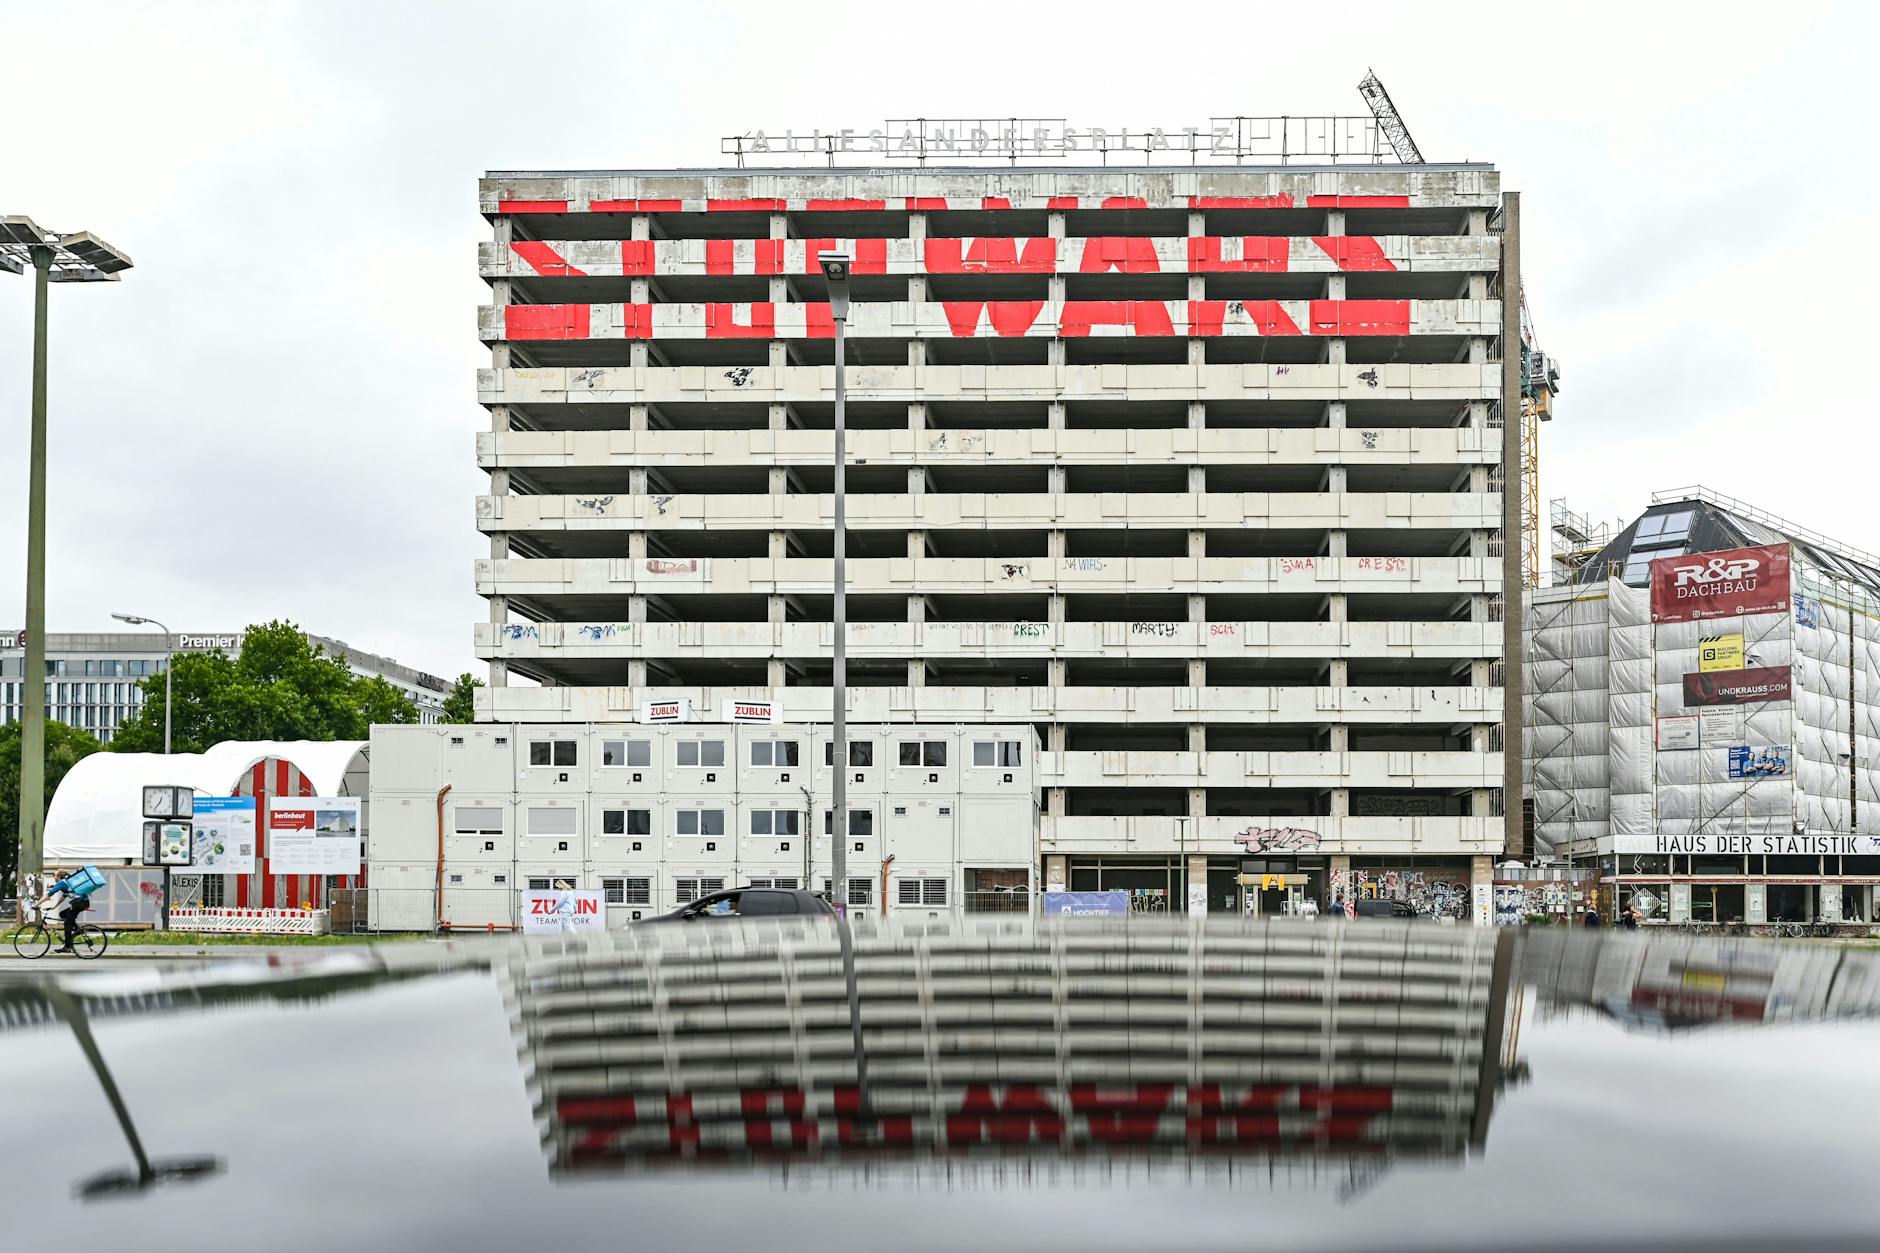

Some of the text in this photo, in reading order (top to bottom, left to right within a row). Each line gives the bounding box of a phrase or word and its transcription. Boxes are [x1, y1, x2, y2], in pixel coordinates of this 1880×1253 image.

[1673, 558, 1760, 586] R&P
[1676, 578, 1757, 599] DACHBAU
[179, 634, 233, 648] Premier
[1718, 683, 1788, 696] UNDKRAUSS.COM
[1656, 836, 1858, 853] HAUS DER STATISTIK
